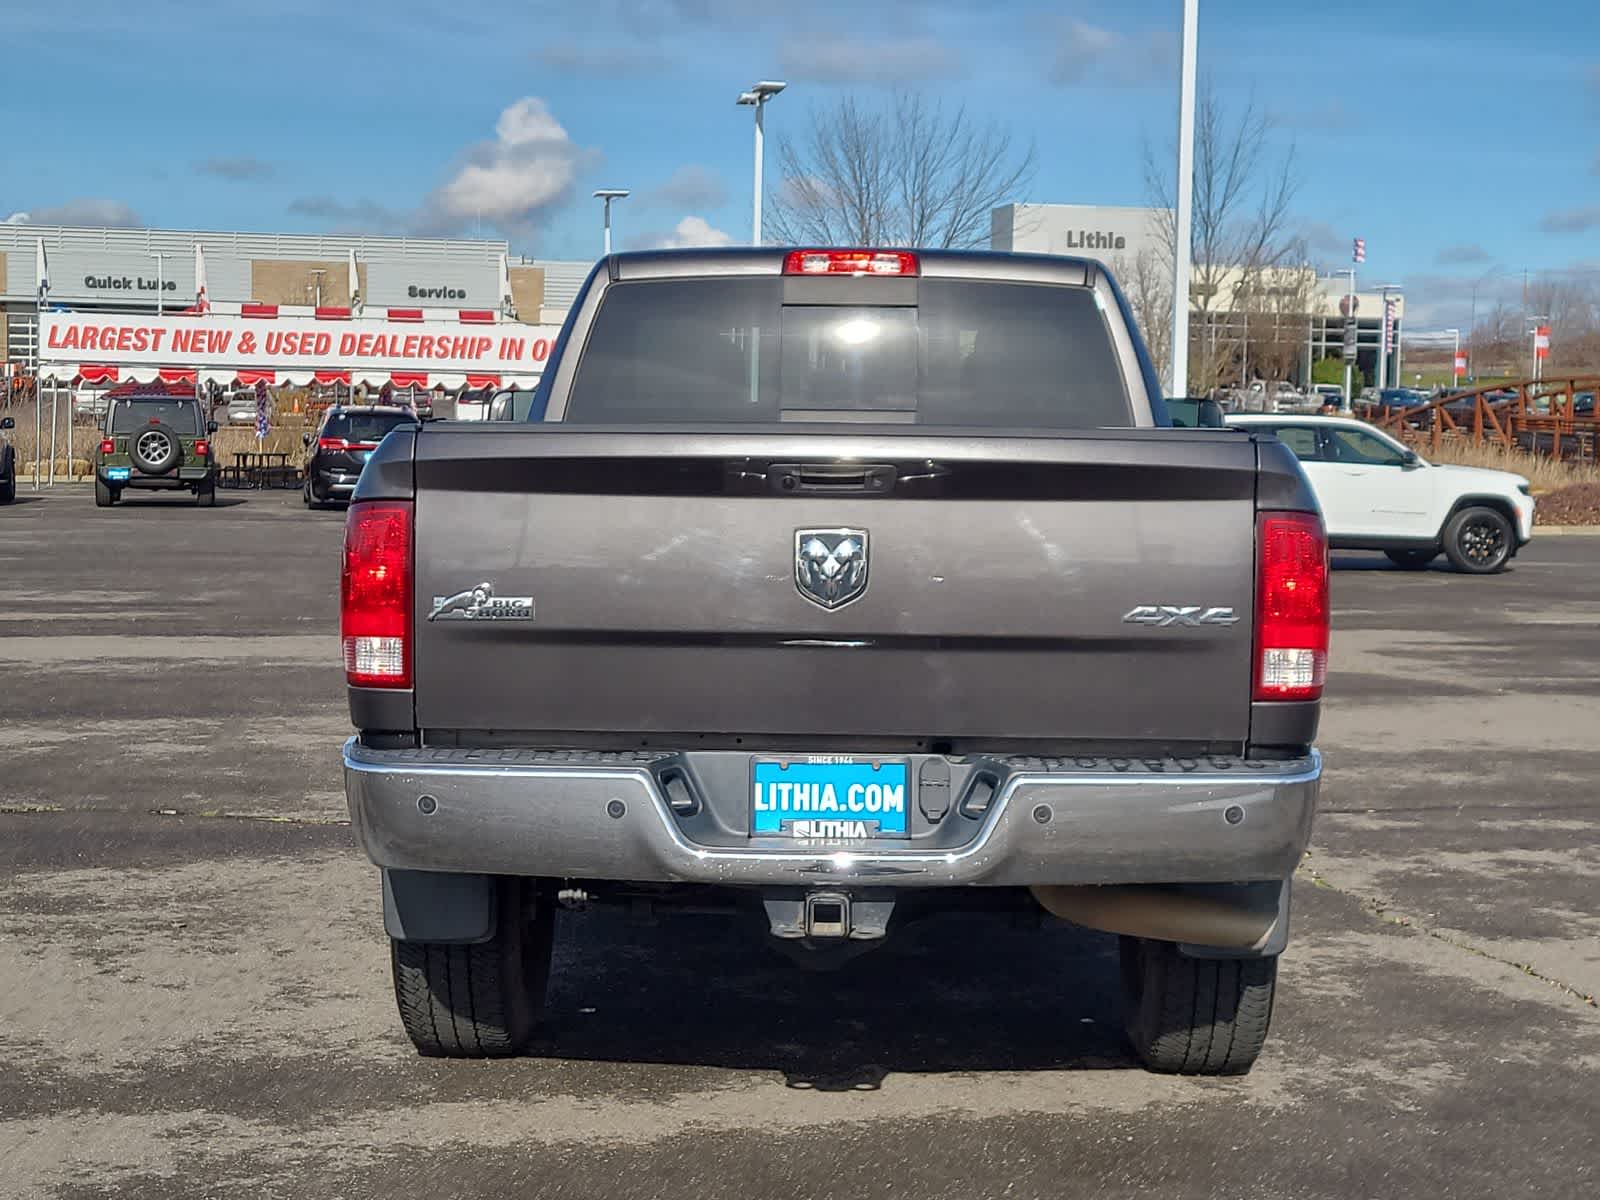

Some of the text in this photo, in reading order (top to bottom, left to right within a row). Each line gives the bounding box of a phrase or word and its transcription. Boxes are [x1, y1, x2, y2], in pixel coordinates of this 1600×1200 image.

[1066, 230, 1126, 249] Lithia
[84, 275, 177, 291] Quick Lube
[408, 285, 467, 299] Service
[47, 325, 167, 352] LARGEST
[171, 329, 232, 353] NEW
[236, 331, 258, 355] &
[264, 332, 332, 357] USED
[339, 333, 493, 360] DEALERSHIP
[498, 337, 526, 361] IN
[808, 755, 833, 764] SINCE
[754, 782, 904, 813] LITHIA.COM
[810, 820, 867, 838] LITHIA
